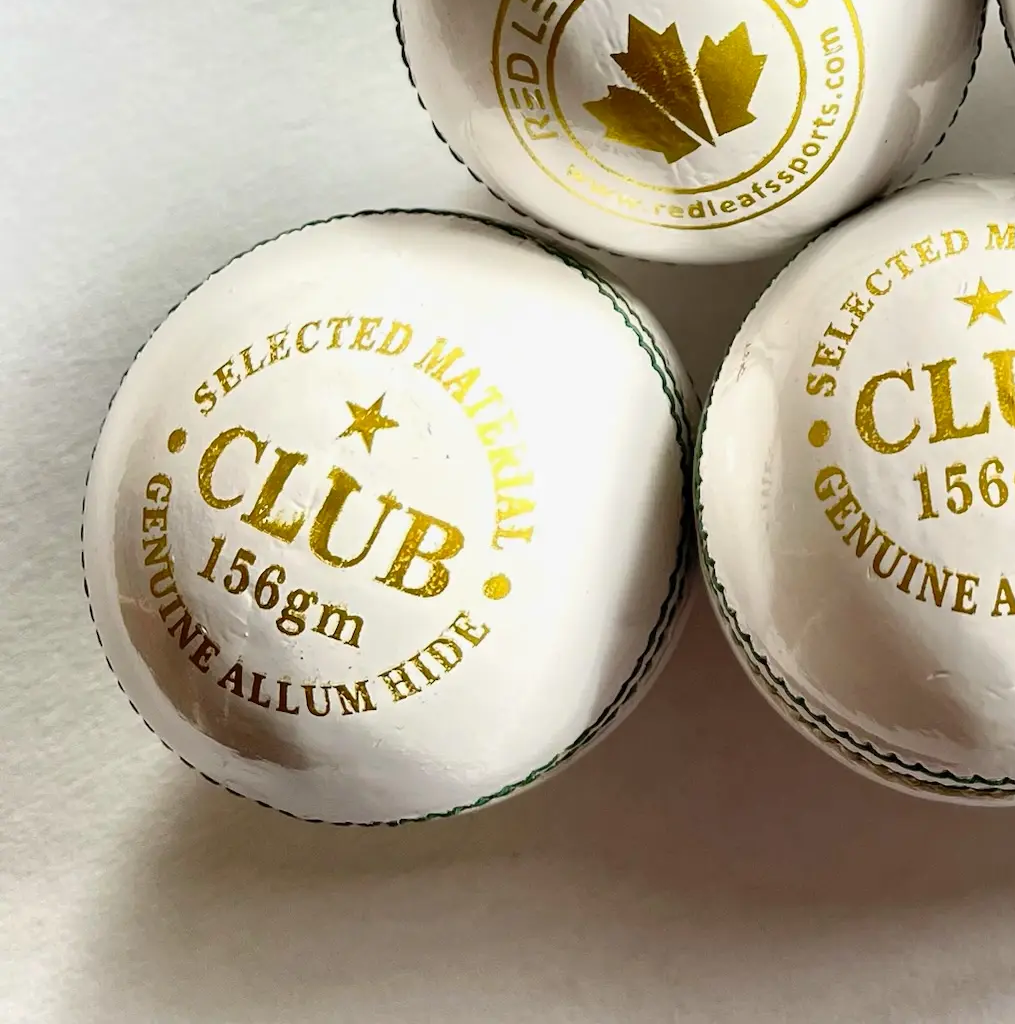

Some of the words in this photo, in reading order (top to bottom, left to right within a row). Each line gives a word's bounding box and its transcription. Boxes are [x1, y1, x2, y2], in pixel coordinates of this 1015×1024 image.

[506, 53, 558, 141] RED
[806, 228, 970, 398] SELECTED
[194, 315, 413, 416] SELECTED
[413, 335, 537, 551] MATERIAL
[198, 425, 465, 598] CLUB
[142, 472, 221, 674] GENUINE
[218, 658, 378, 717] ALLUM
[377, 609, 491, 703] HIDE
[197, 532, 365, 649] 156gm
[814, 465, 980, 616] GENUINE
